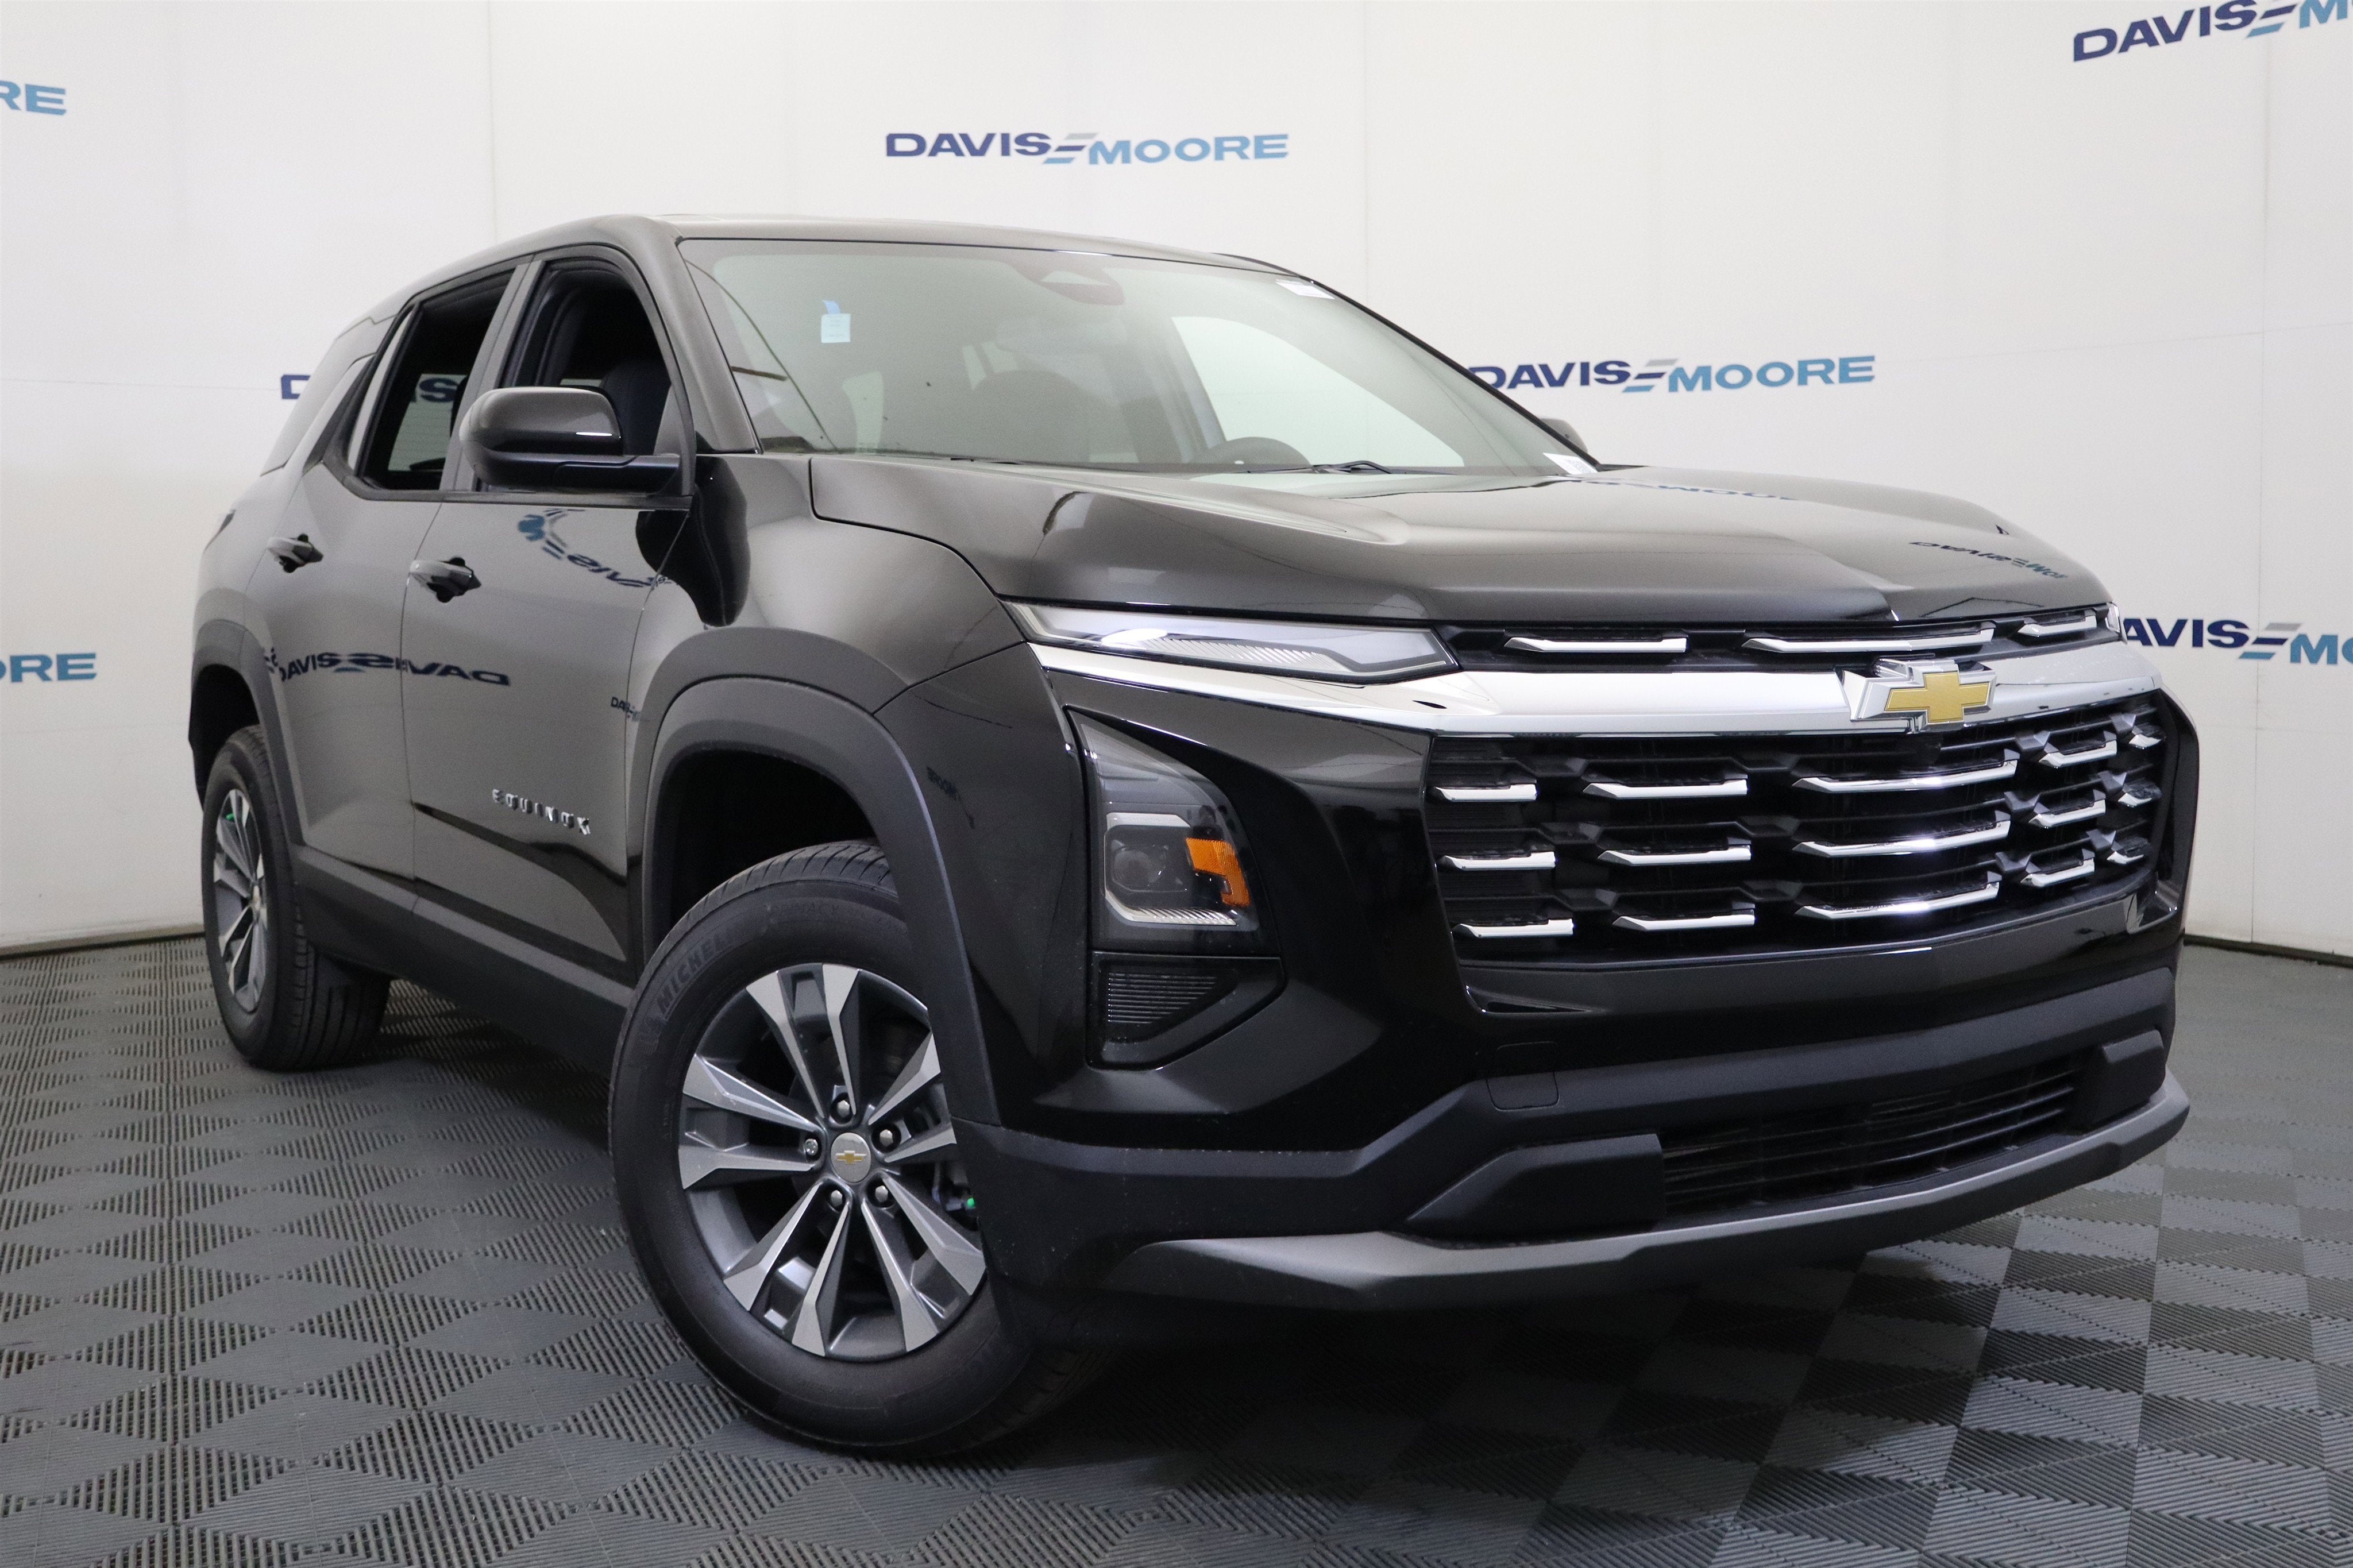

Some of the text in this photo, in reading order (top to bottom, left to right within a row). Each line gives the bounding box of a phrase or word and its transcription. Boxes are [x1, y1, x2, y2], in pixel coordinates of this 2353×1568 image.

[2073, 0, 2256, 61] DAVIS
[886, 133, 1289, 165] DAVIS MOORE
[1668, 355, 1875, 392] MOORE
[2123, 617, 2248, 648] AVIS
[0, 652, 97, 683] RE
[656, 926, 736, 1015] MICHEL
